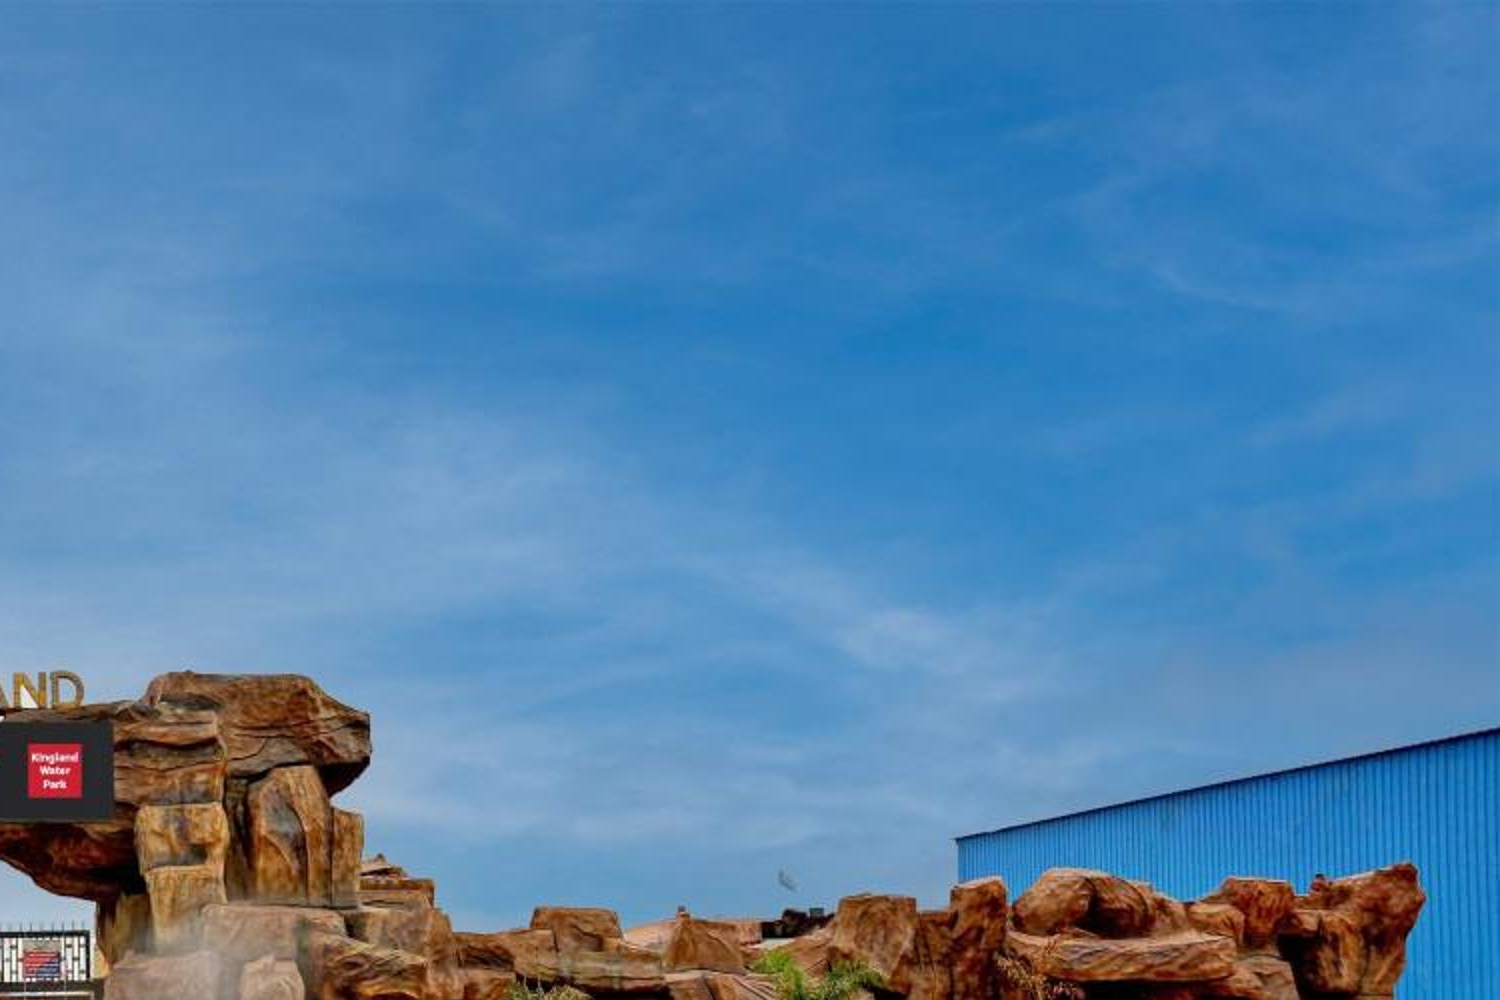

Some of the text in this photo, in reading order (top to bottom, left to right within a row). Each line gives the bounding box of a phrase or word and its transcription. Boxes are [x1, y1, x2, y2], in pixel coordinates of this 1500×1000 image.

[31, 751, 79, 765] Kingland
[39, 765, 71, 775] Water
[43, 779, 68, 789] Park
